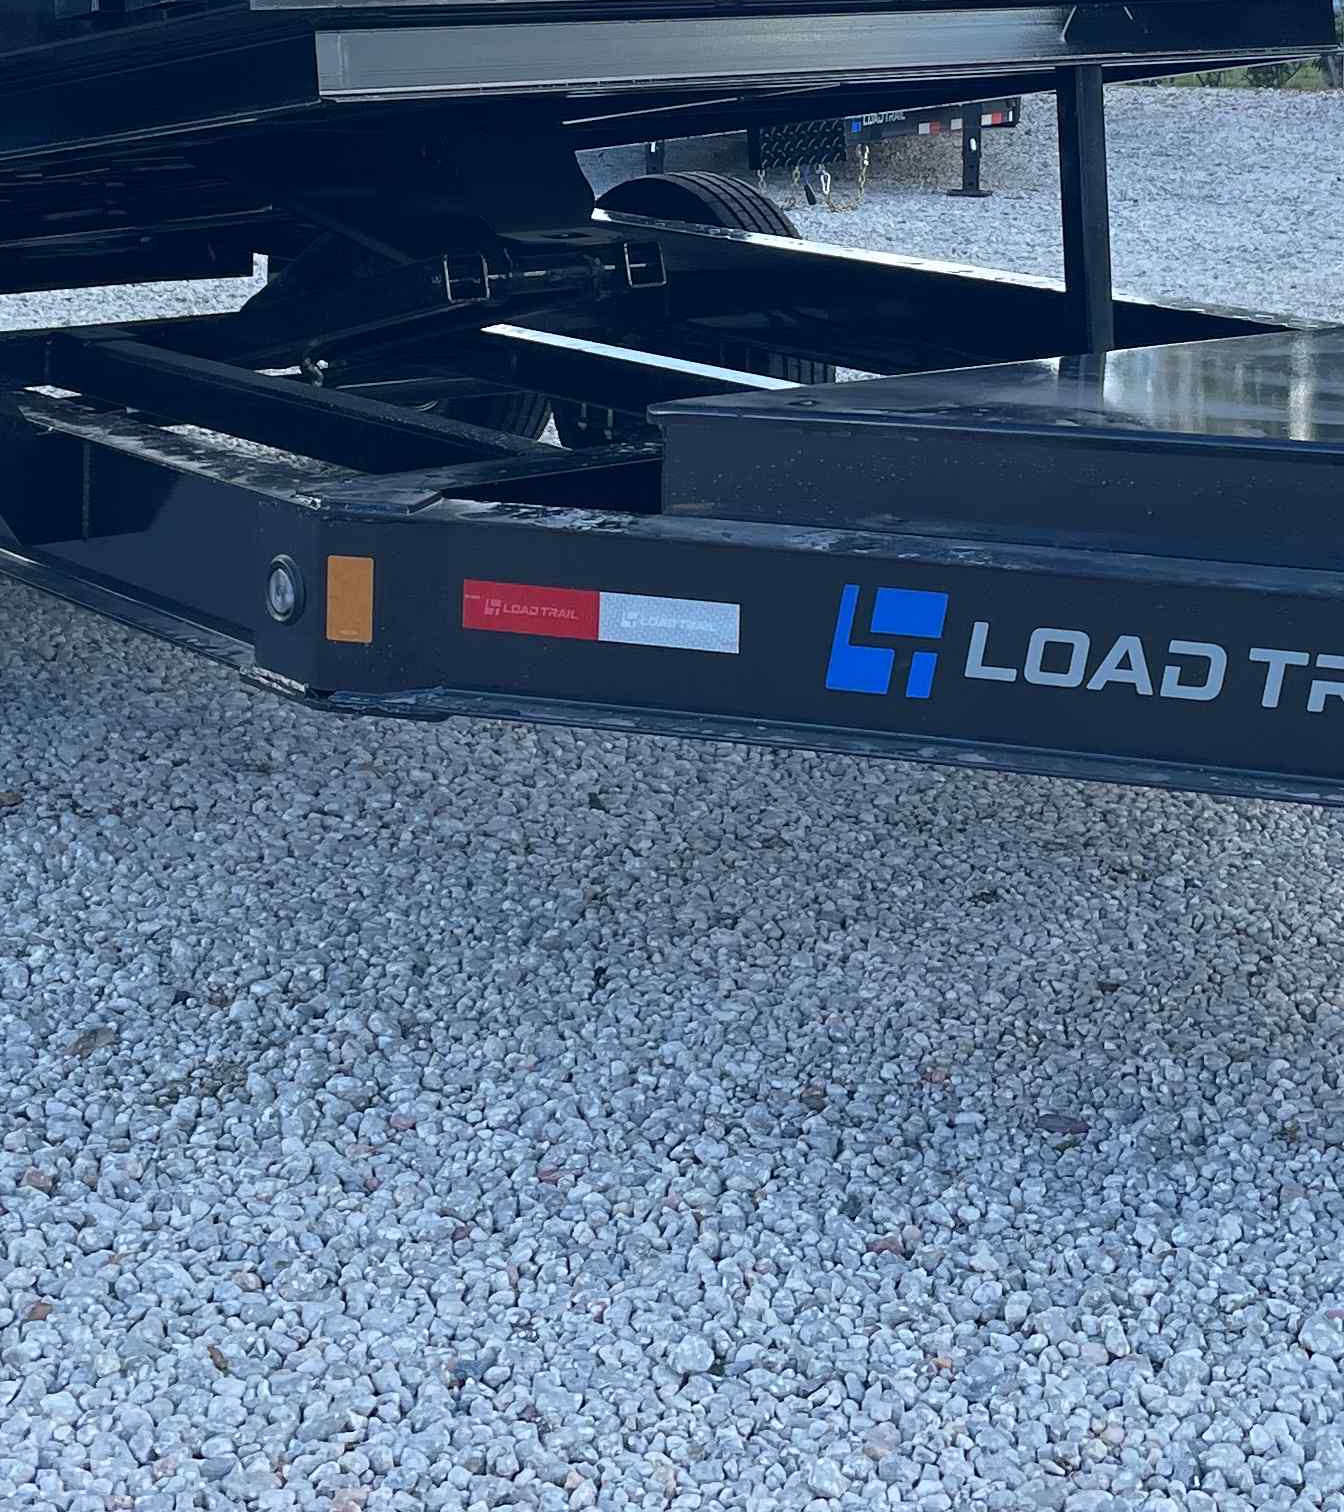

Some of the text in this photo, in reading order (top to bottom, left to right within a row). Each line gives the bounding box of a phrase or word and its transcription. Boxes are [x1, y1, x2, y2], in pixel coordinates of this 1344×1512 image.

[503, 602, 579, 620] LOAD TRAIL
[963, 620, 1228, 702] LOAD
